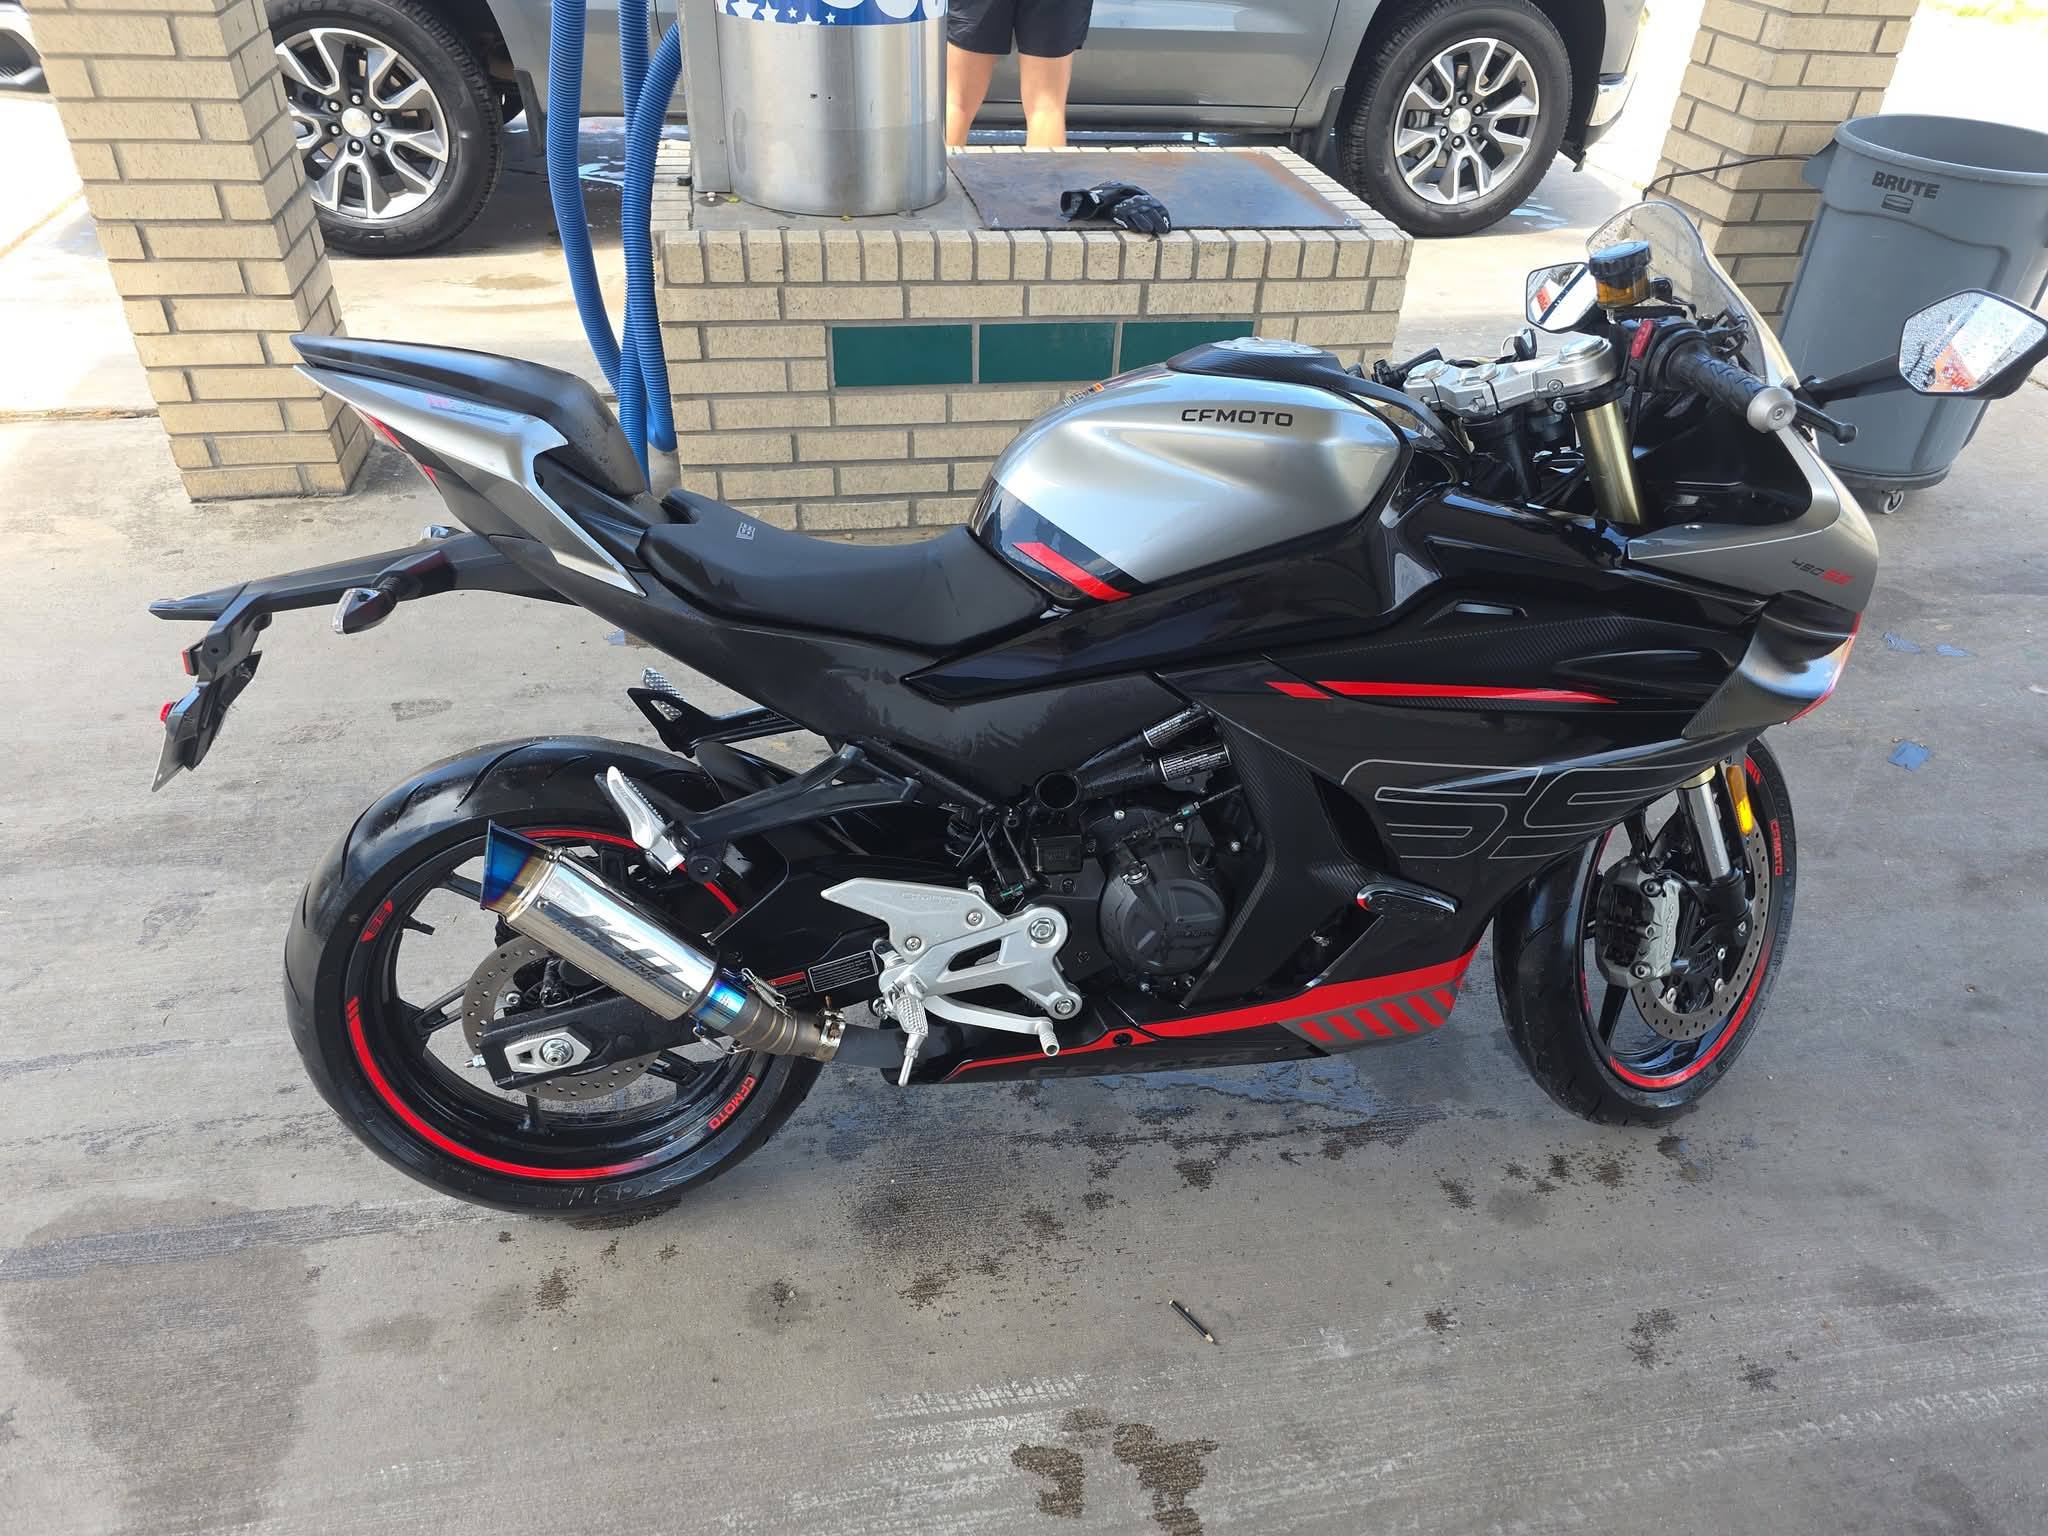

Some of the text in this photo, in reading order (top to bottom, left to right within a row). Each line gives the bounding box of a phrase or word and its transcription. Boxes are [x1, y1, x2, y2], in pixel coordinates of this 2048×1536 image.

[1871, 170, 1941, 200] BRUTE
[1181, 408, 1294, 428] CFMOTO
[1769, 819, 1784, 877] CFMOTO
[707, 1075, 757, 1130] CFMOTO
